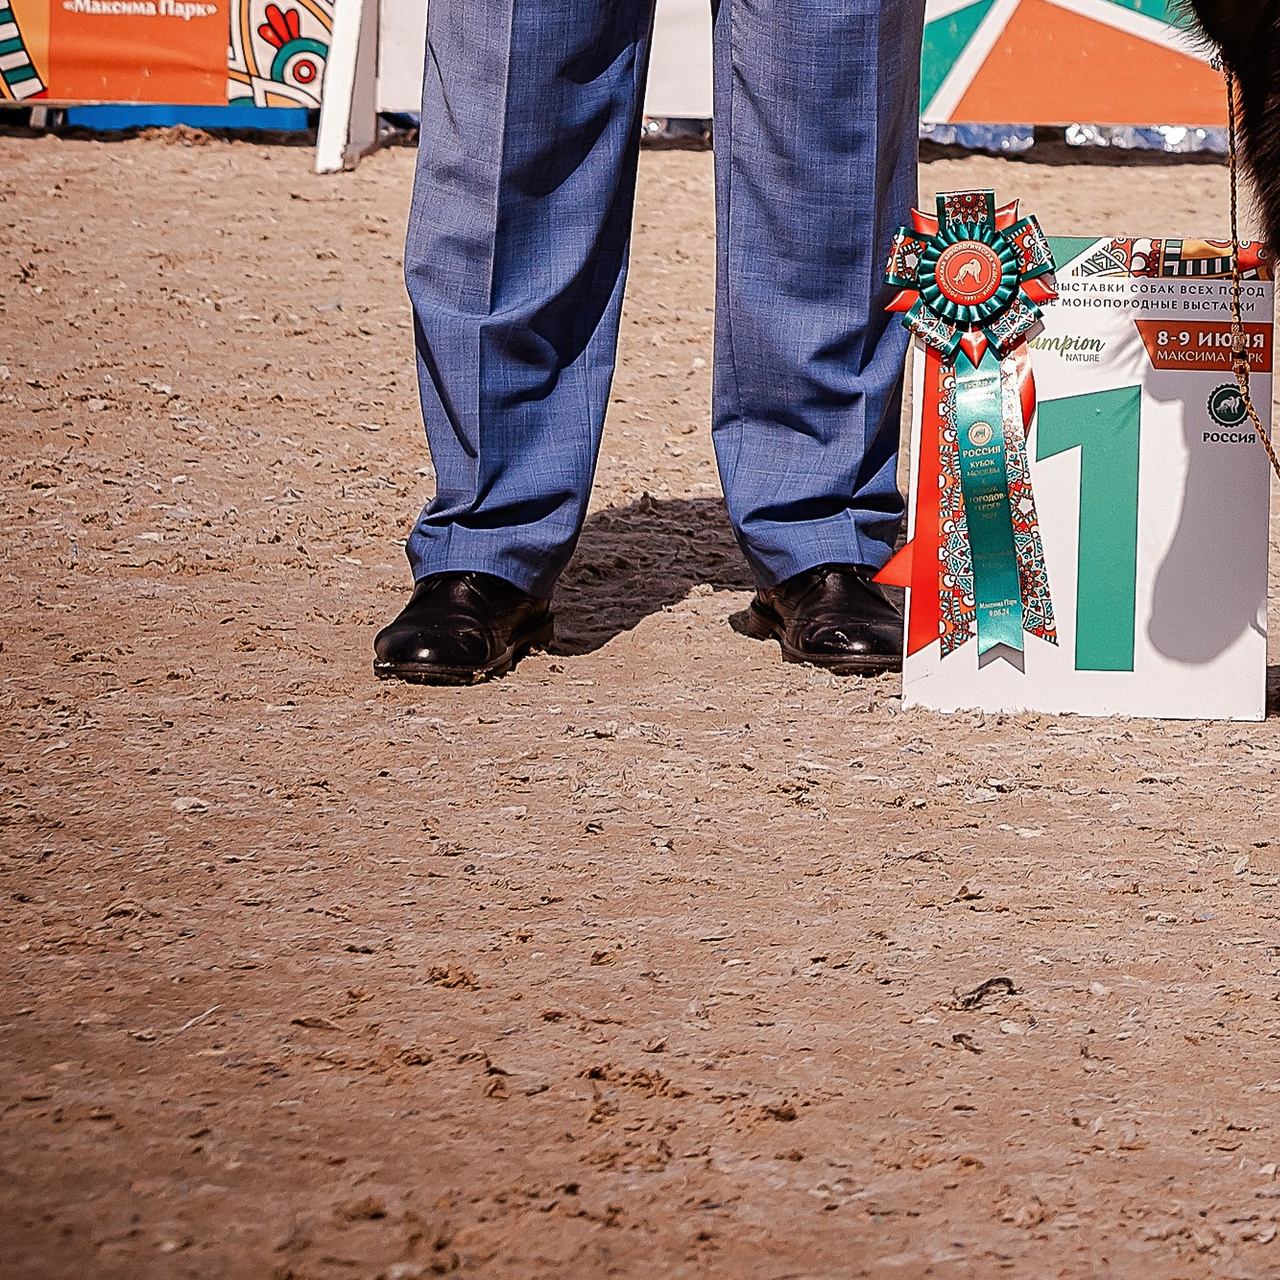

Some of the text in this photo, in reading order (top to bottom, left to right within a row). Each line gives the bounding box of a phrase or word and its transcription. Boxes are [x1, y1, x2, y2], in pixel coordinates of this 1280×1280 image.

[1053, 282, 1125, 293] ВЫСТАВКИ
[1130, 284, 1175, 294] СОБАК
[1180, 285, 1213, 295] ВСЕХ
[1061, 298, 1178, 310] МОНОПОРОДНЫЕ
[1156, 331, 1191, 346] 8-9
[1028, 334, 1106, 358] ampion
[1065, 353, 1100, 362] NATURE
[1156, 349, 1226, 362] МАКСИМА
[1202, 432, 1257, 444] РОССИЯ
[962, 445, 1002, 458] РОССИЯ
[1035, 384, 1142, 672] 1
